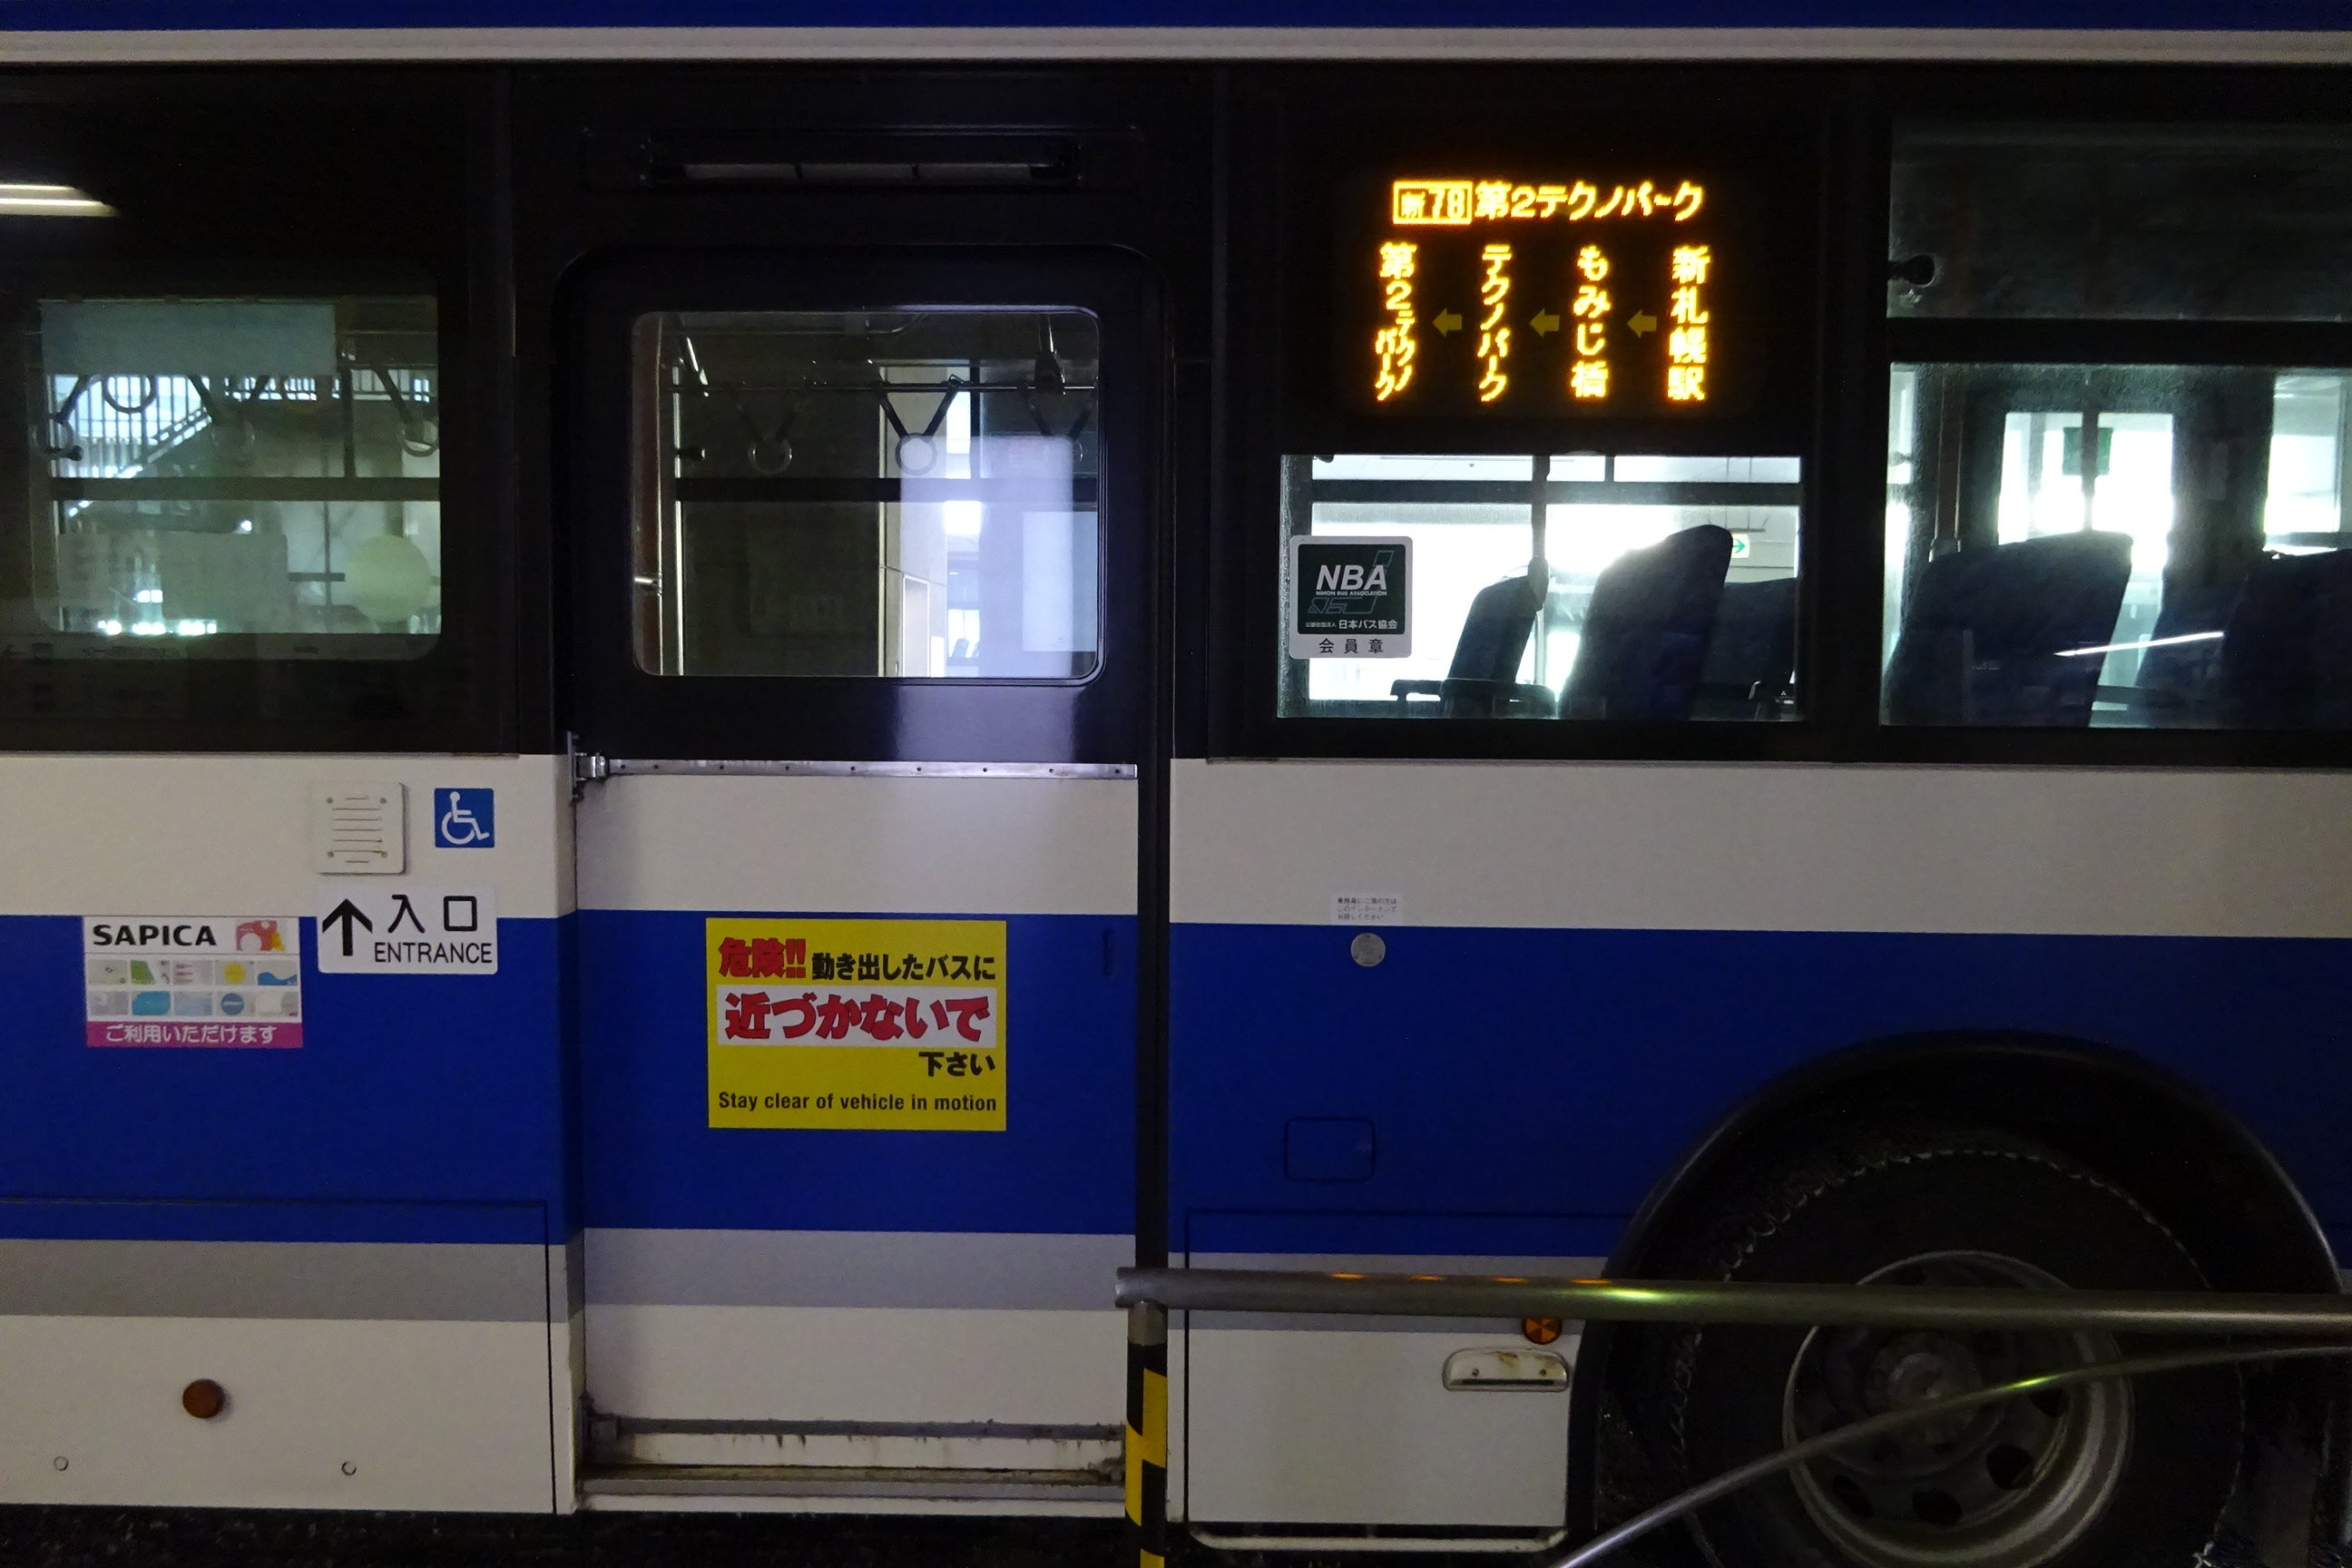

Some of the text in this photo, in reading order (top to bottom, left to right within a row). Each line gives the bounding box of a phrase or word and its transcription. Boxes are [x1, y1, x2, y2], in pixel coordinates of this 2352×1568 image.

[1475, 180, 1703, 221] 第2テクノパーク
[1477, 243, 1513, 402] テクノパーク
[1571, 245, 1612, 398] もみじ橋
[1667, 245, 1711, 401] 新札幌駅
[1316, 564, 1387, 590] NBA
[1338, 619, 1397, 630] 日本バス協会
[1318, 638, 1384, 654] 会員章
[387, 894, 478, 935] 入口
[92, 924, 217, 946] SAPICA
[374, 941, 493, 965] ENTRANCE
[812, 952, 996, 981] 動き出したバスに
[724, 991, 991, 1042] 近づかないで
[106, 1023, 278, 1044] ご利用いただけます
[918, 1051, 996, 1077] 下さい
[719, 1092, 996, 1112] Stay clear of vehicle in motion
